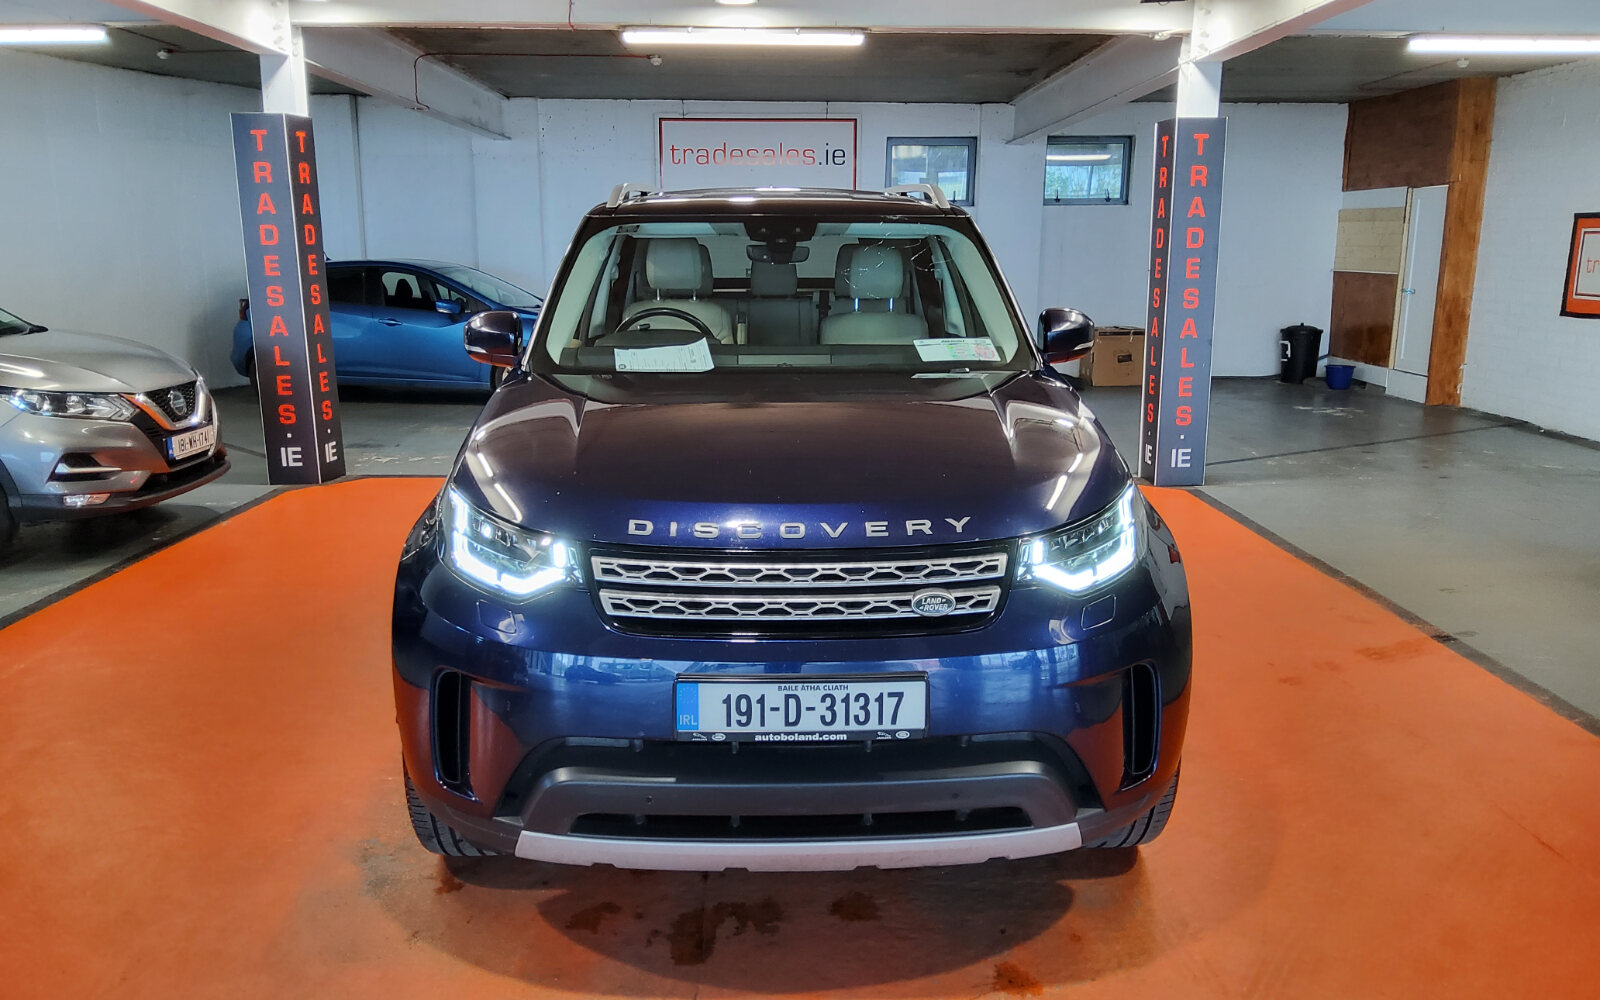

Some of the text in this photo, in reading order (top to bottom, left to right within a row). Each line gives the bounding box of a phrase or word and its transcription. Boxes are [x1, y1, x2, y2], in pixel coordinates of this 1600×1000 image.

[669, 141, 846, 166] tradesales.ie
[628, 516, 971, 539] DISCOVERY
[921, 597, 942, 605] LAND
[923, 603, 948, 611] ROVER
[721, 691, 905, 728] 191-D-31317
[679, 714, 698, 726] IRL
[754, 732, 848, 742] autoboland.com
